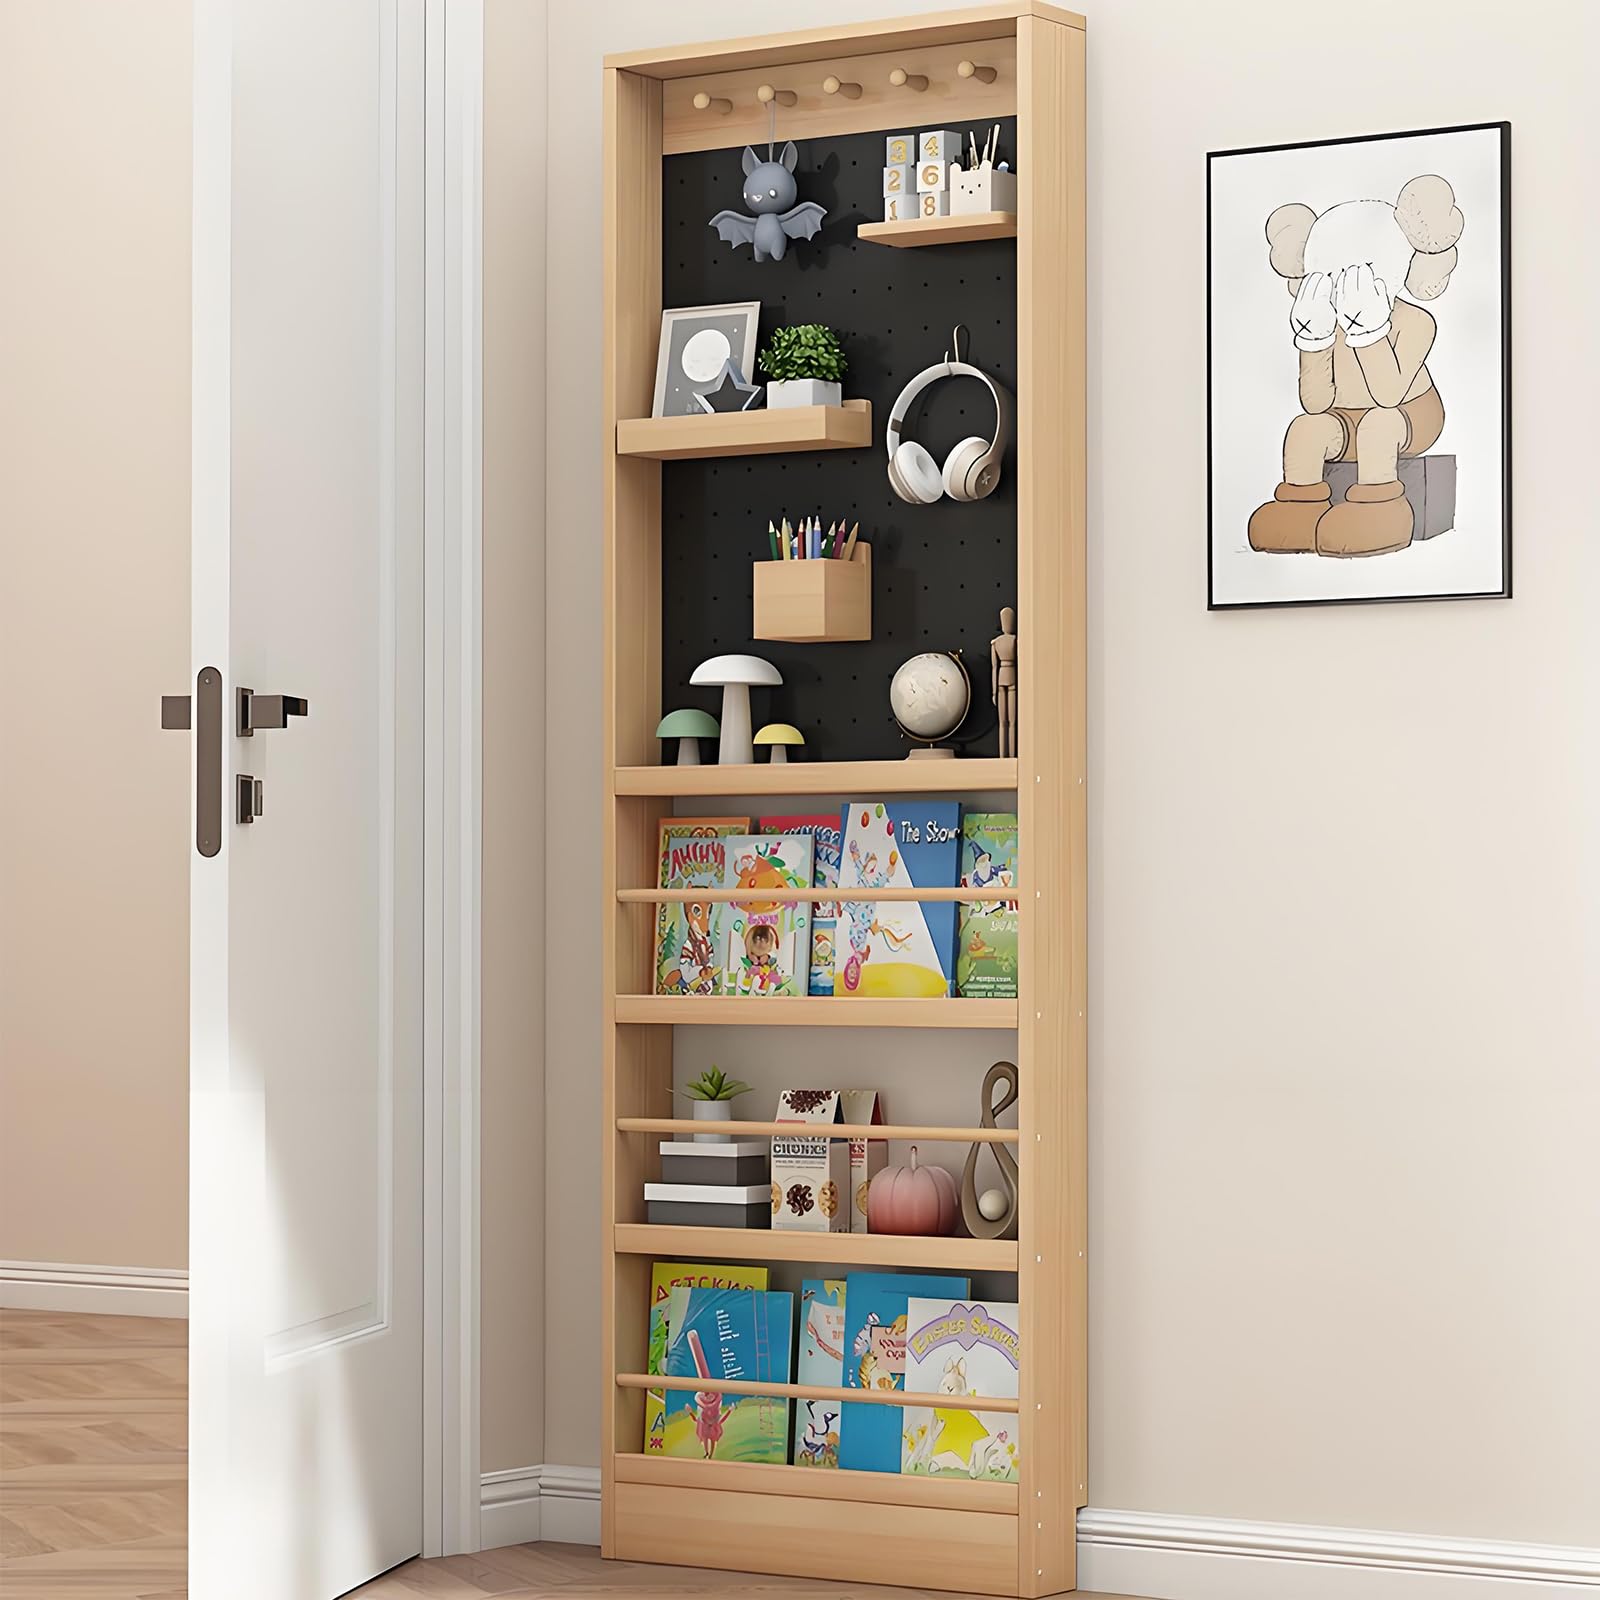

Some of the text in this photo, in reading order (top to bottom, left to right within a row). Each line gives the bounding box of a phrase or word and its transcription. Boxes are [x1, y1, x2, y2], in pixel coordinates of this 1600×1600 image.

[923, 135, 939, 157] 4
[887, 169, 901, 192] 2
[921, 164, 939, 186] 6
[889, 199, 898, 221] 1
[923, 195, 936, 217] 8
[901, 820, 920, 843] The
